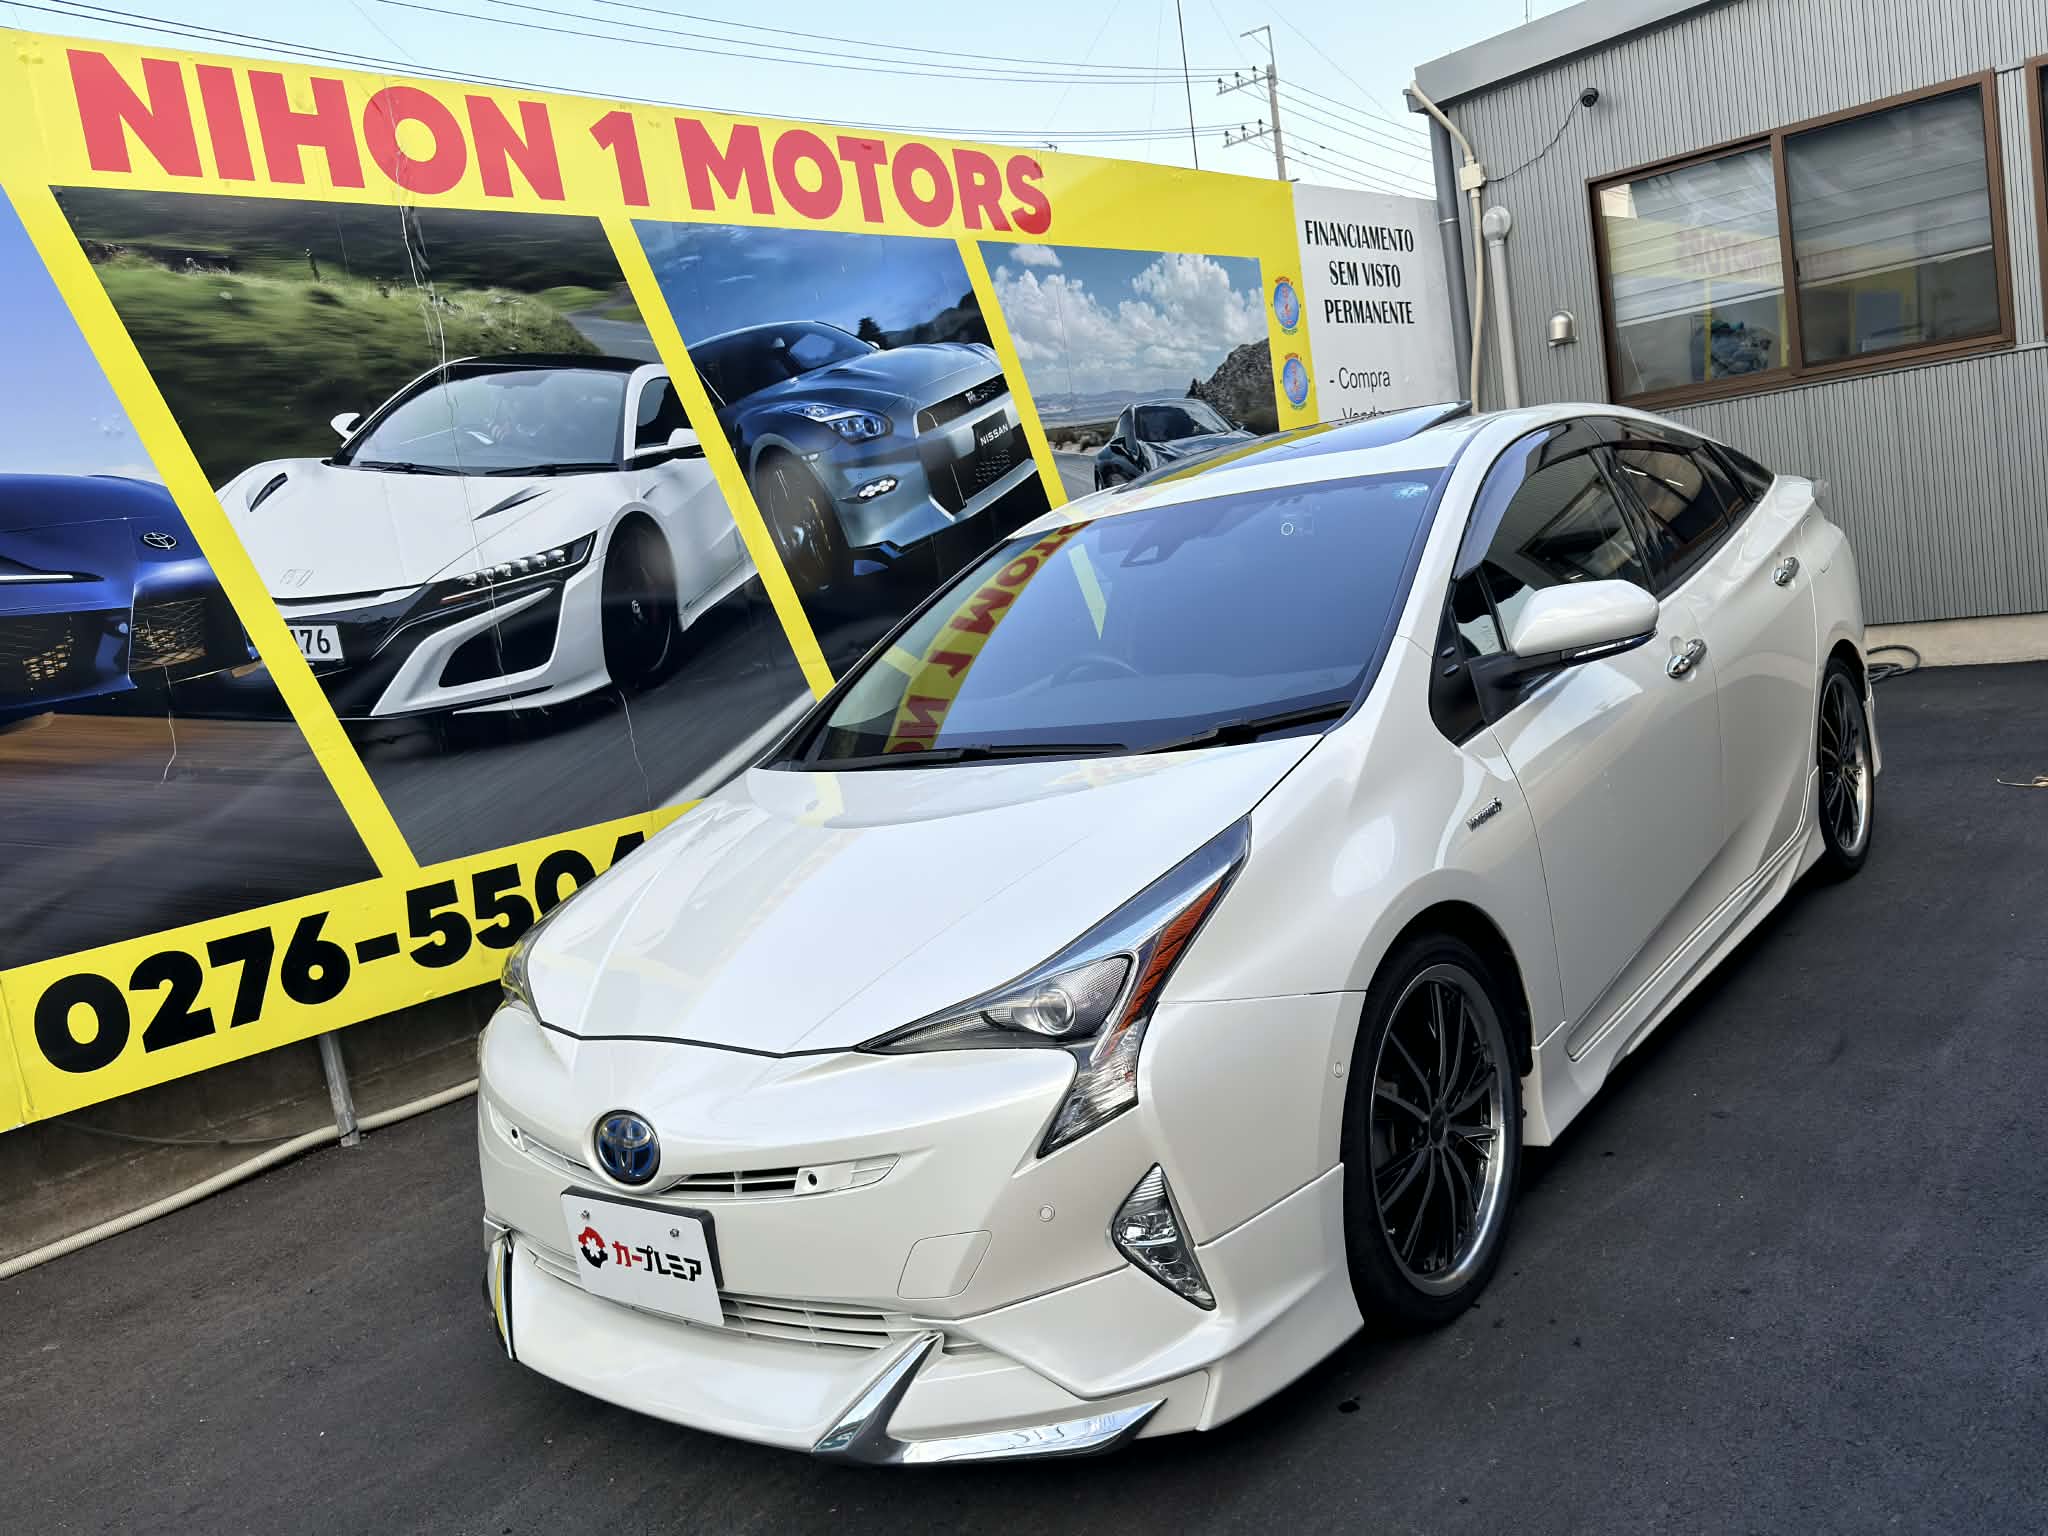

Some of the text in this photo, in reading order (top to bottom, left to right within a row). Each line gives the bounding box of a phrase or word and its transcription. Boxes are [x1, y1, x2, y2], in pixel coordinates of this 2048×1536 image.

[66, 49, 1051, 235] NIHON 1 MOTORS
[1305, 220, 1415, 252] FINANCIAMENTO
[1329, 261, 1401, 288] SEM VISTO
[1324, 299, 1415, 324] PERMANENTE
[1339, 367, 1391, 392] Compra
[980, 424, 1009, 446] NISSAN
[34, 831, 645, 1073] 0276-550
[612, 1240, 702, 1281] カープレミア
